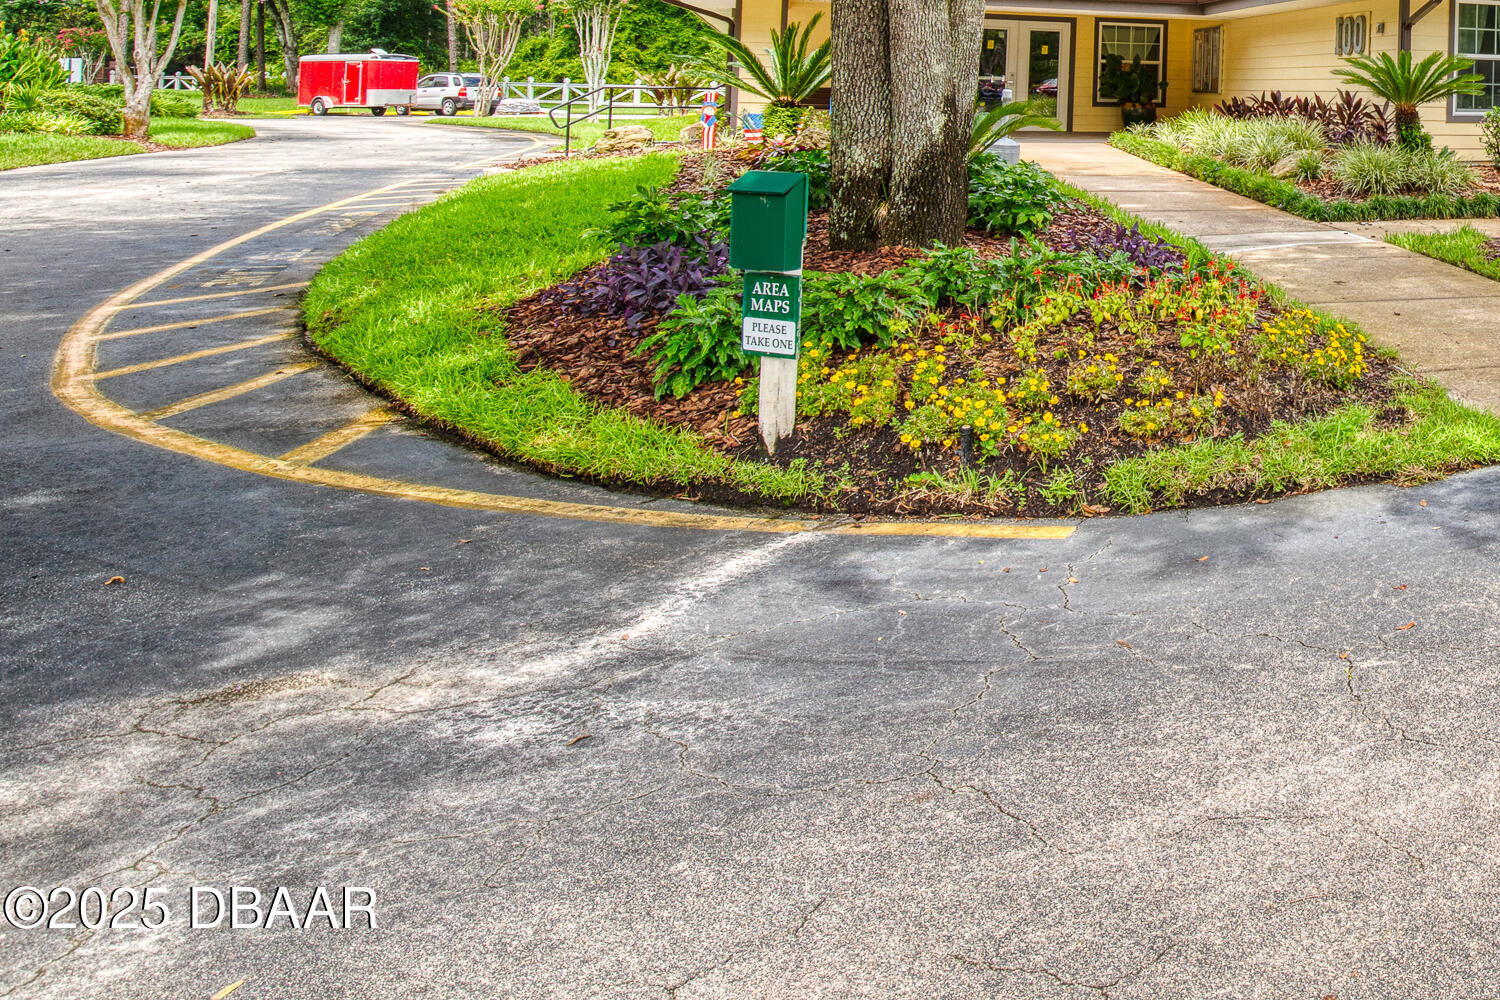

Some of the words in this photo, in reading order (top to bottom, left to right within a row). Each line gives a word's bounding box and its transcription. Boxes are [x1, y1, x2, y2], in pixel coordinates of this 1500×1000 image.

[1334, 14, 1367, 56] 100
[752, 281, 789, 297] AREA
[751, 297, 790, 314] MAPS
[751, 321, 787, 335] PLEASE
[745, 335, 771, 348] TAKE
[772, 337, 793, 350] ONE
